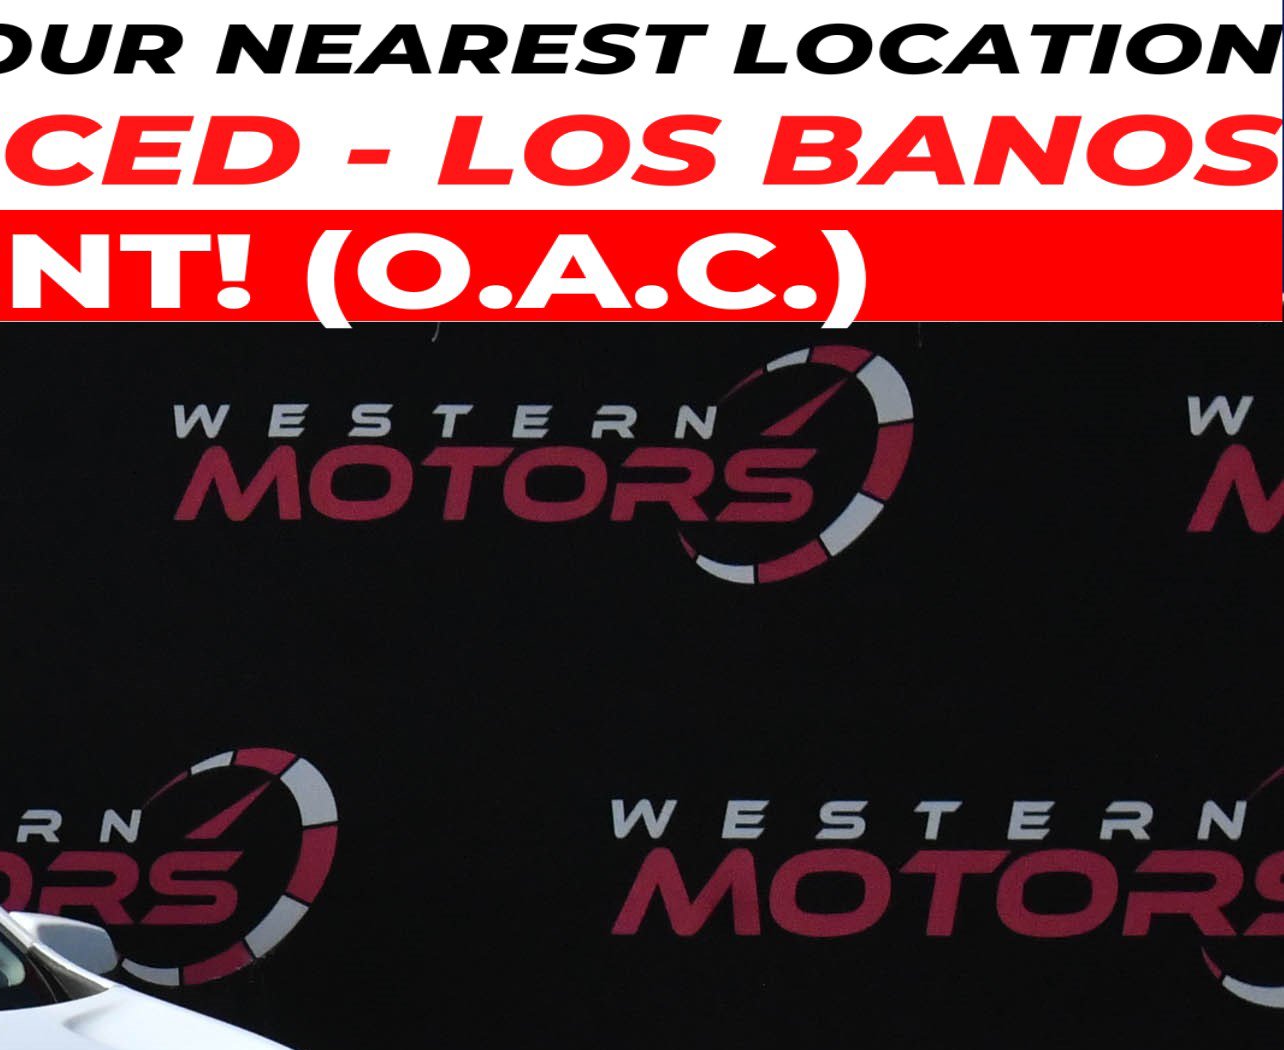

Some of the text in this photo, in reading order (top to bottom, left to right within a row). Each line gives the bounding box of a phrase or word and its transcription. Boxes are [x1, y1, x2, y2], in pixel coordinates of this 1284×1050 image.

[173, 404, 717, 440] WESTERN
[174, 445, 816, 523] MOTORS
[611, 799, 1247, 840] WESTERN
